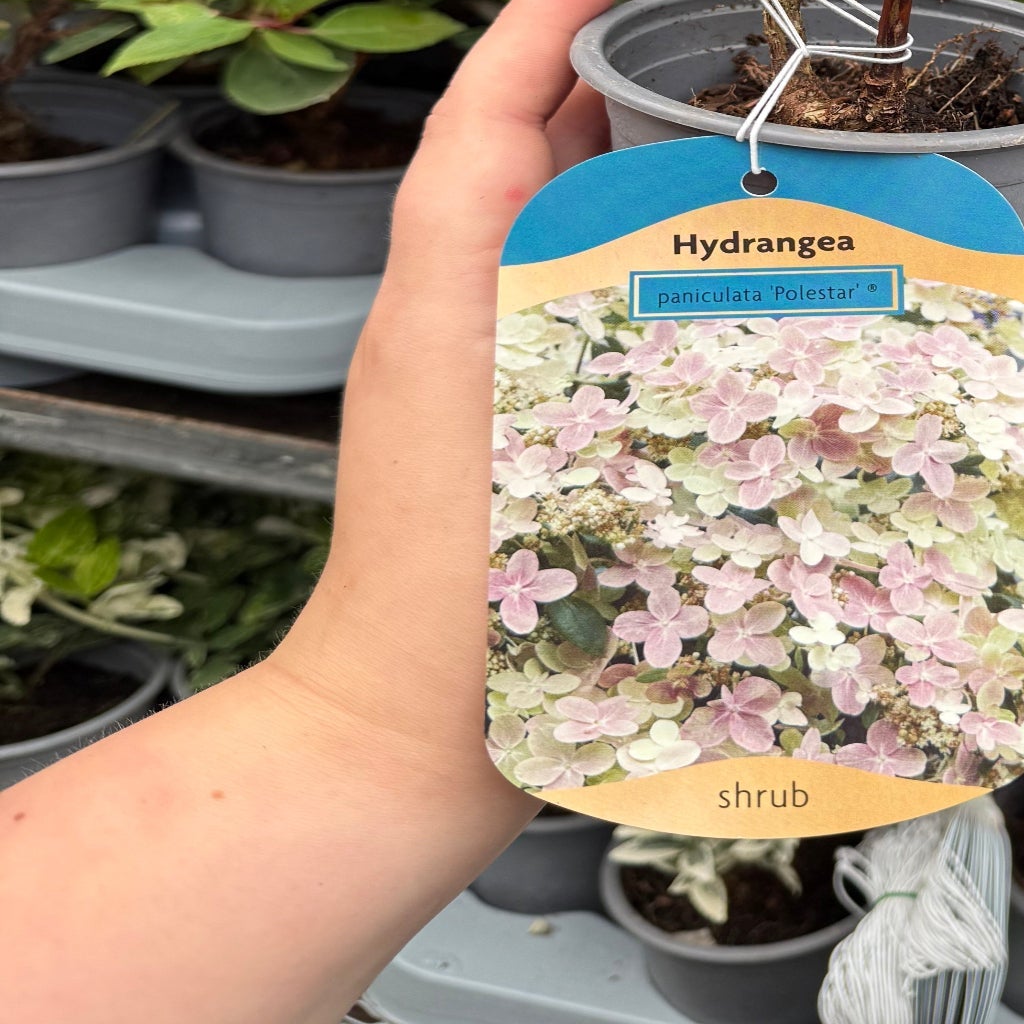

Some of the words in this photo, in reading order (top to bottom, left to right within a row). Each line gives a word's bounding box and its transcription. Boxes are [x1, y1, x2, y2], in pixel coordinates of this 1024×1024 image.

[673, 230, 855, 262] Hydrangea
[658, 286, 762, 308] paniculata
[770, 283, 860, 301] 'Polestar'
[718, 781, 809, 809] shrub
